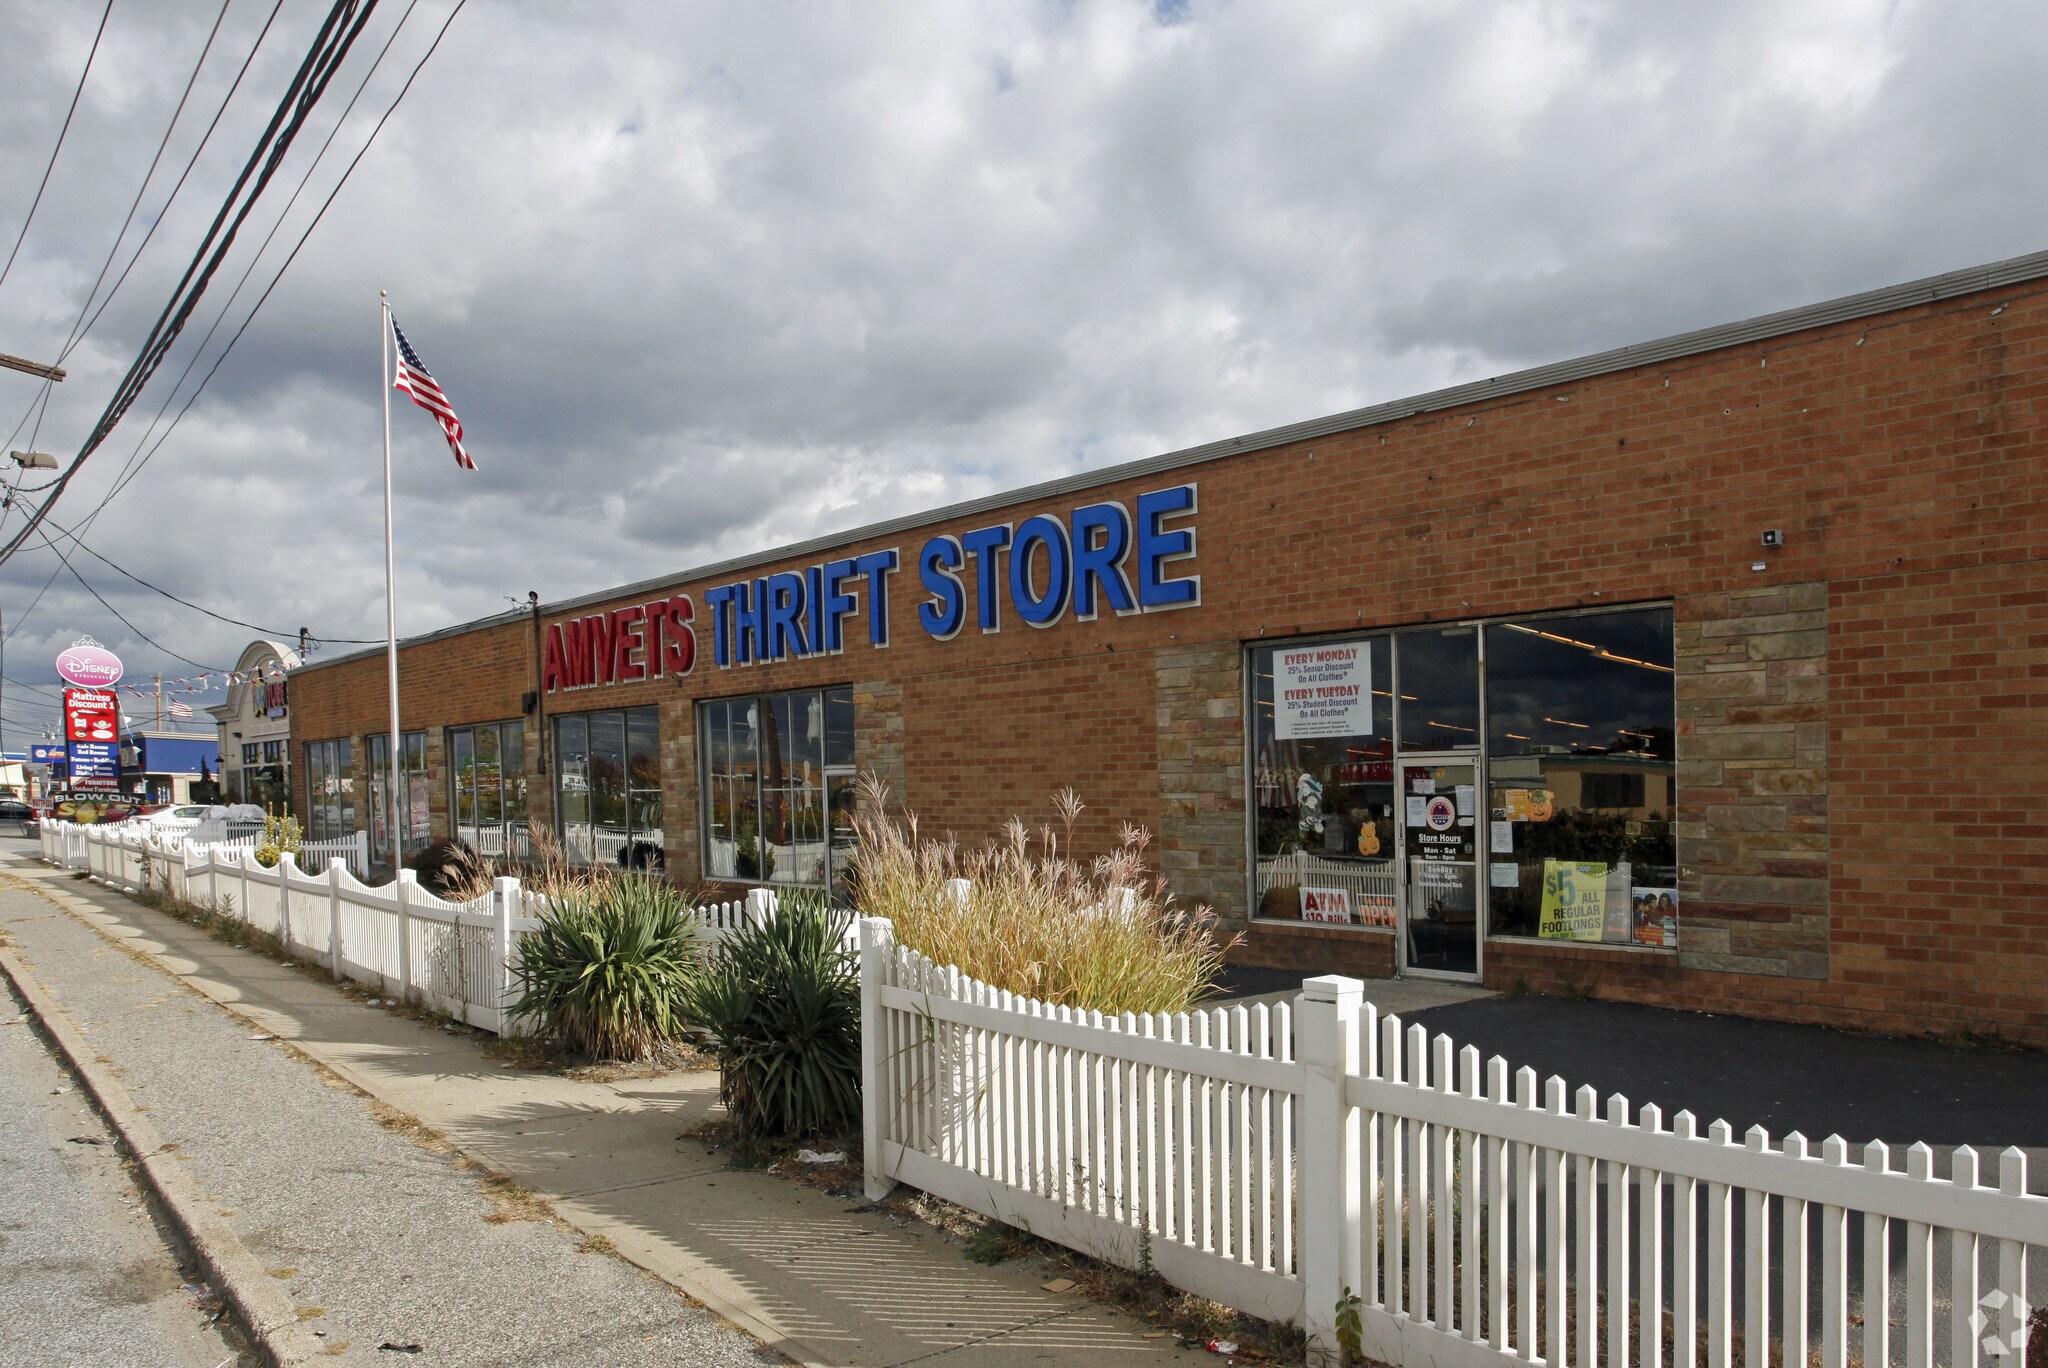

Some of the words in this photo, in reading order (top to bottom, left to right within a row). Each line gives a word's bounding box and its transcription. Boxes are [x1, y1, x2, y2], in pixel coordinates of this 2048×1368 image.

[544, 594, 695, 693] AMVETS
[704, 546, 899, 669] THRIFT
[918, 483, 1201, 641] STORE
[1285, 652, 1315, 665] EVERY
[1316, 648, 1358, 662] MONDAY
[1288, 667, 1302, 675] 25%
[1303, 664, 1323, 673] Senior
[1325, 662, 1354, 671] Discount
[1298, 675, 1307, 684] On
[1308, 674, 1317, 683] All
[72, 692, 110, 702] Mattress
[1285, 688, 1315, 700] EVERY
[1316, 685, 1360, 699] TUESDAY
[69, 699, 107, 709] Discount
[109, 702, 115, 710] 1
[1288, 701, 1302, 710] 25%
[1303, 700, 1328, 709] Student
[1329, 697, 1358, 707] Discount
[1300, 710, 1308, 719] On
[1310, 709, 1318, 718] All
[55, 793, 104, 802] BLOW
[108, 794, 141, 804] OUT
[1419, 834, 1438, 842] Store
[1440, 834, 1461, 842] Hours
[1546, 869, 1576, 907] $5
[1305, 891, 1347, 912] ATM
[1582, 892, 1600, 904] ALL
[1554, 905, 1600, 919] REGULAR
[1542, 918, 1601, 933] FOOTLONGS
